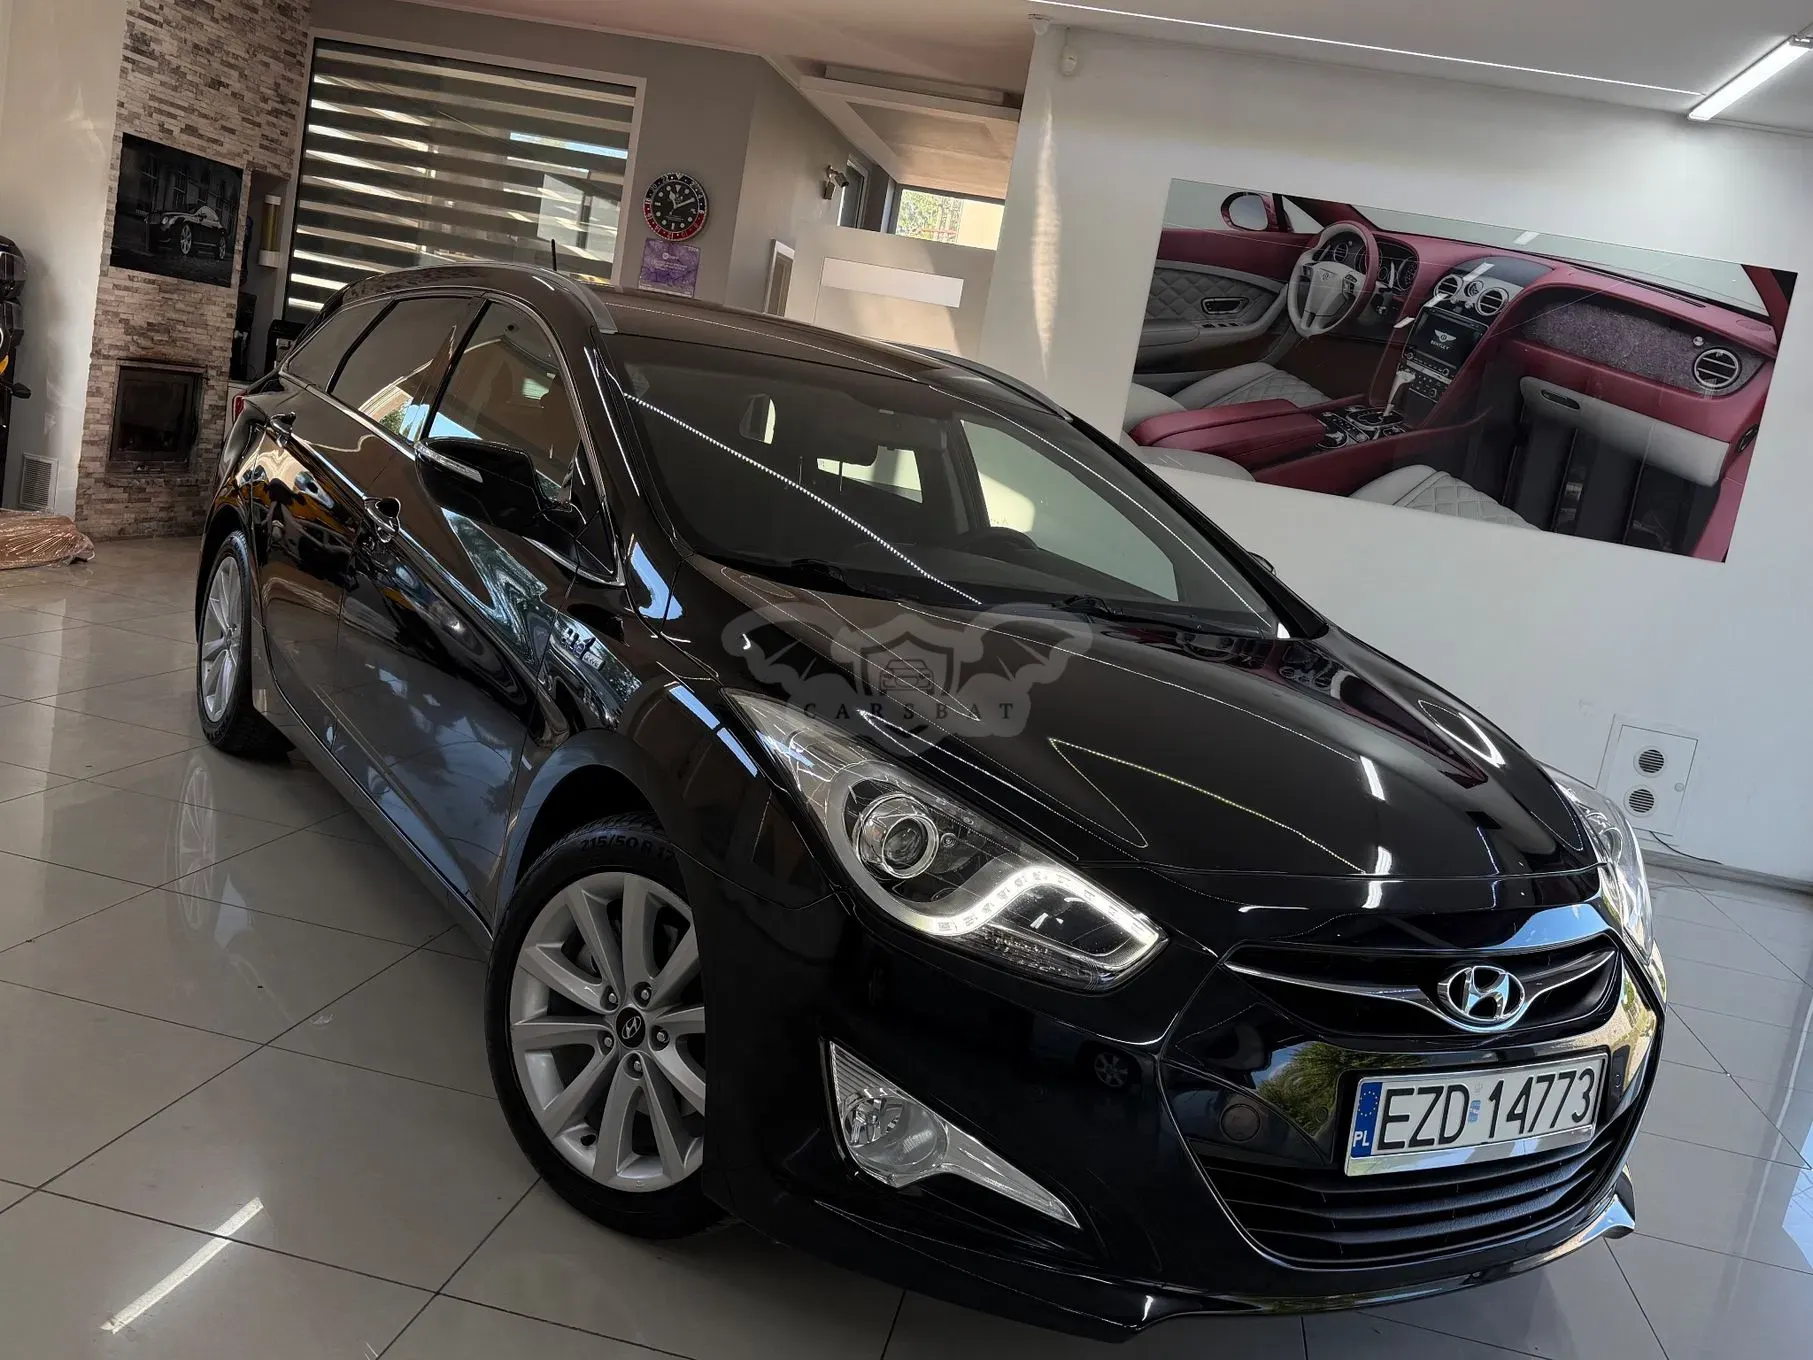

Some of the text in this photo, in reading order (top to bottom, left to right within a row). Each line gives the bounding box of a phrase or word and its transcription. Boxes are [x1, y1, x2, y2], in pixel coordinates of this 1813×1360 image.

[580, 834, 639, 851] 215/50
[640, 840, 653, 854] R
[1376, 1067, 1596, 1151] EZD 14773
[1352, 1130, 1370, 1148] PL
